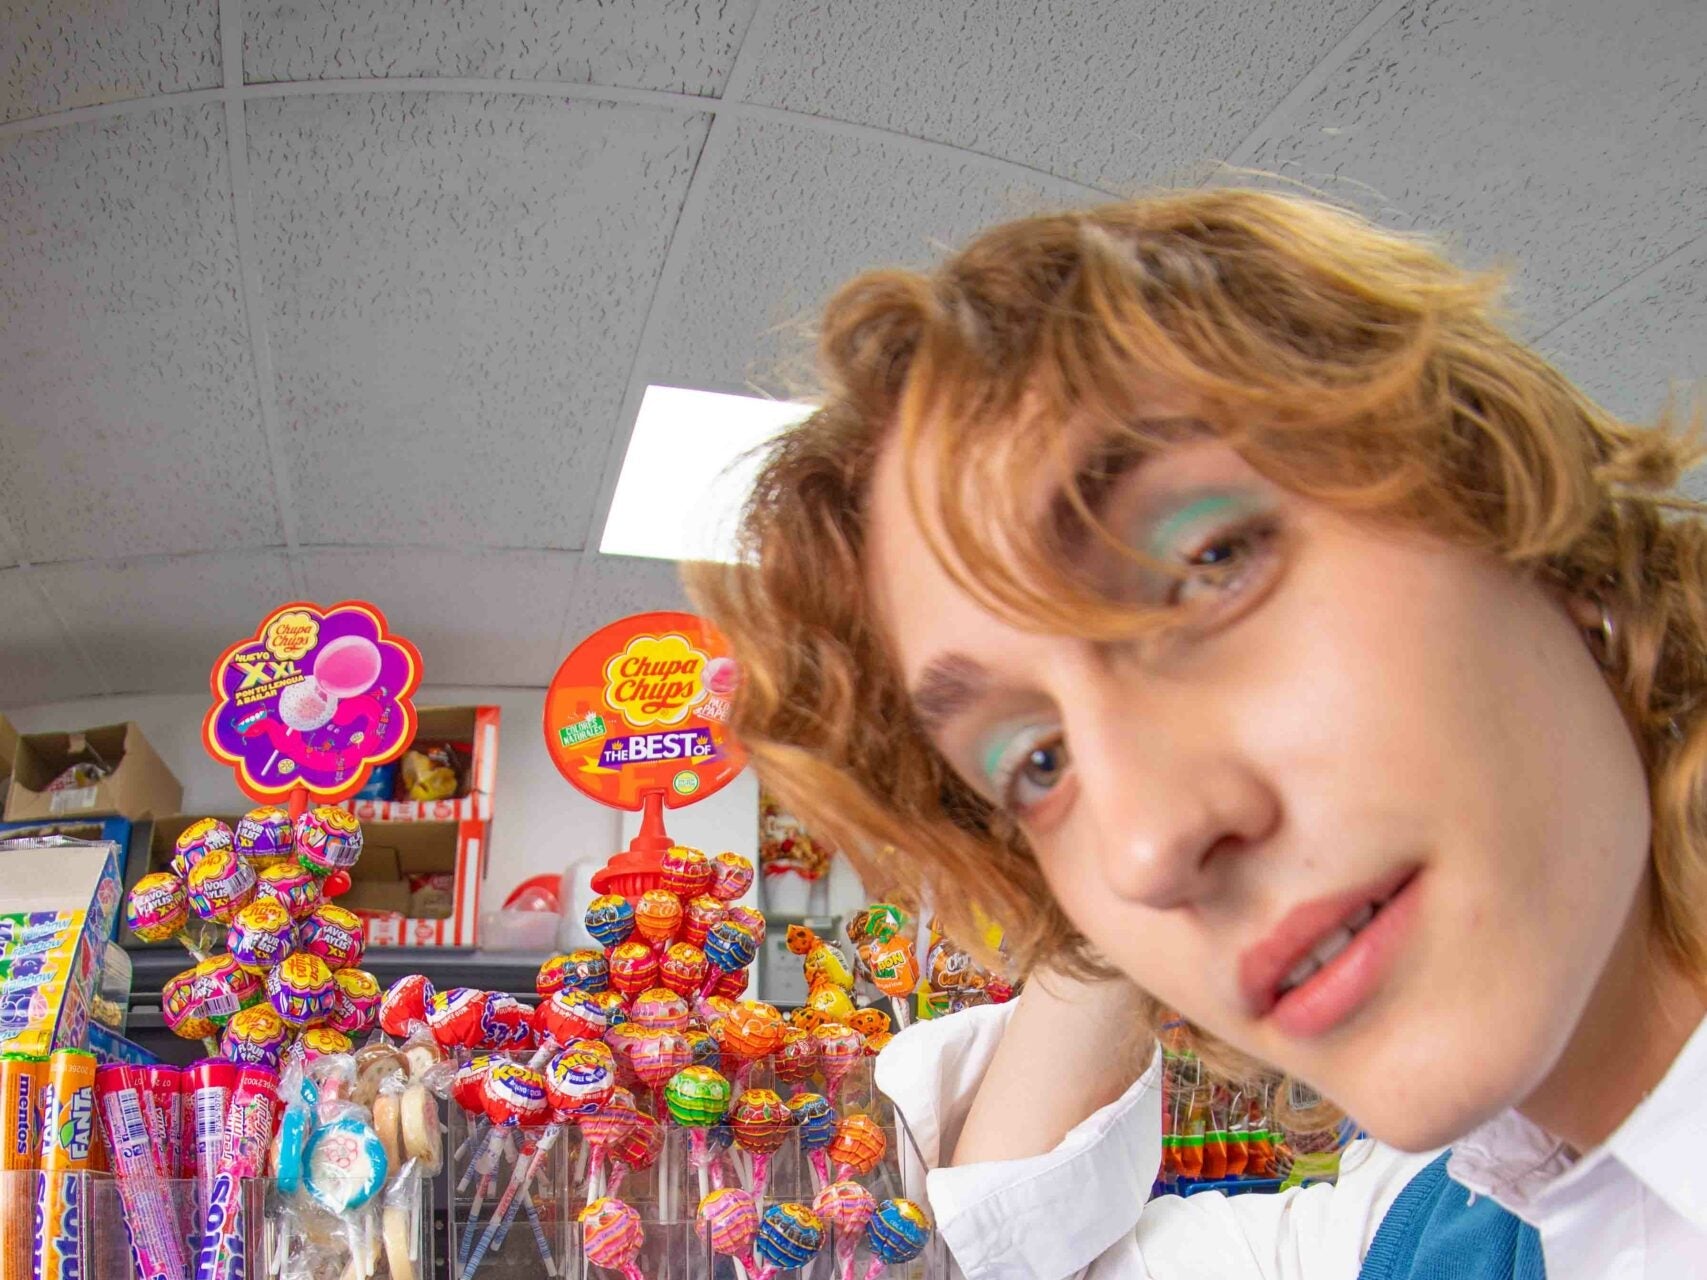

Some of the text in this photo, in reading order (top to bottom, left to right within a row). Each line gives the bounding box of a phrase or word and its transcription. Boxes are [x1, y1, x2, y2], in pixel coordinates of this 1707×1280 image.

[272, 634, 310, 653] Chups
[275, 623, 313, 638] Chupa
[235, 651, 270, 663] NUEVO
[620, 656, 699, 682] Chupa
[231, 660, 302, 690] XXL
[235, 674, 305, 700] PON TU LENGUA
[236, 689, 278, 706] A BAILAR
[615, 678, 694, 715] Chups
[563, 725, 605, 747] NATURALES
[565, 718, 598, 737] COLORES
[603, 732, 712, 763] THE BEST OF
[17, 1073, 30, 1155] mentos
[71, 1085, 92, 1160] FANTA
